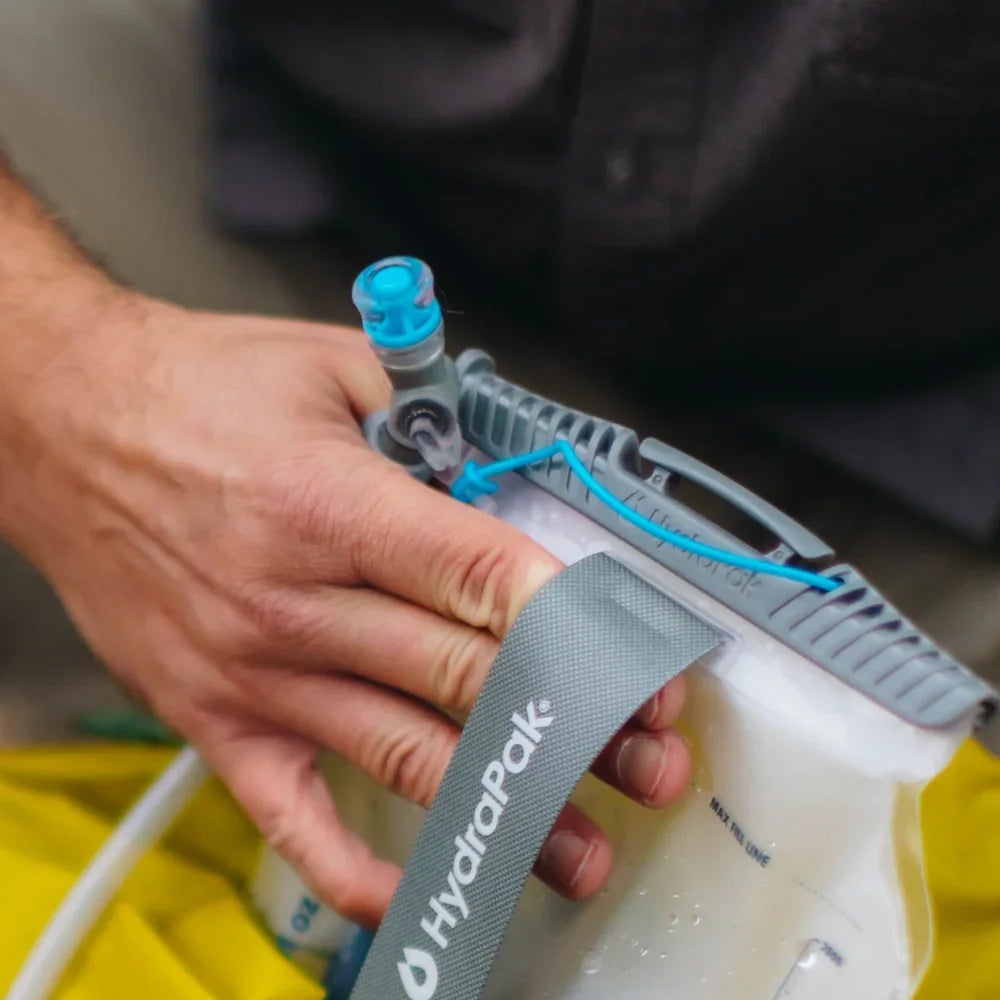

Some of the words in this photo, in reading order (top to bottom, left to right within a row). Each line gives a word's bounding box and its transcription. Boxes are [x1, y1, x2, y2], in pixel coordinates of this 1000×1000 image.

[709, 797, 730, 827] MAX
[730, 822, 745, 847] FILL
[745, 841, 770, 868] LINE
